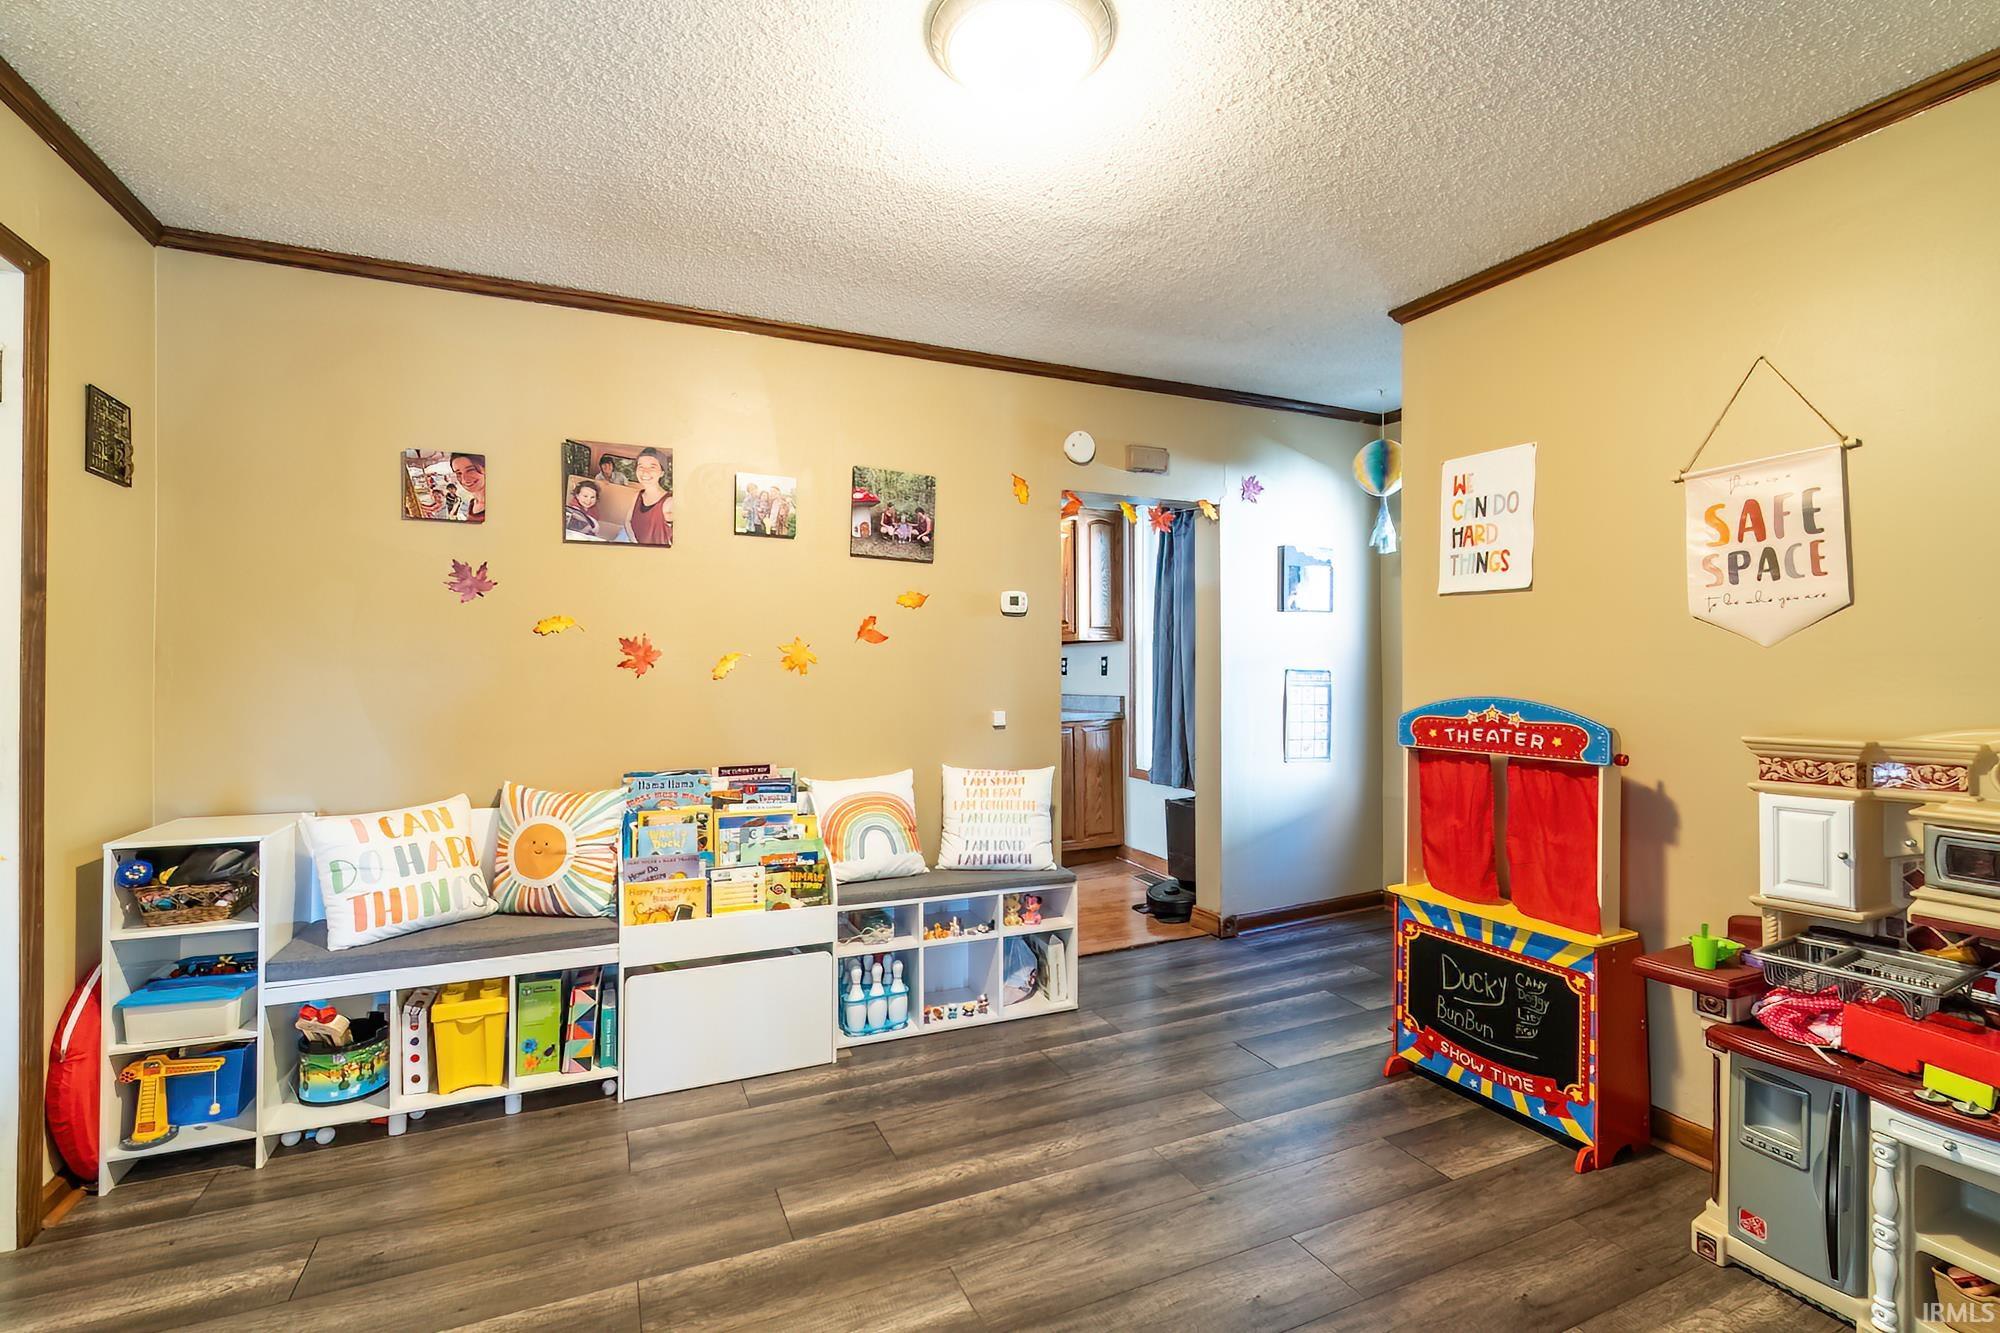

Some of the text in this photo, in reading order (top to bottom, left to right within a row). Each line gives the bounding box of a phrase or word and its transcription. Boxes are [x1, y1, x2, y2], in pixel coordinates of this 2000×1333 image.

[1452, 490, 1520, 521] CAN DO
[1453, 473, 1474, 497] WE
[1452, 523, 1498, 549] HARD
[1704, 487, 1825, 547] SAFE
[1450, 549, 1510, 576] THINGS
[1702, 539, 1828, 587] SPACE
[1444, 727, 1545, 750] THEATER
[350, 806, 455, 844] I CAN
[329, 849, 383, 895] DO
[965, 854, 983, 866] AM
[346, 873, 488, 933] THINGS
[1441, 953, 1507, 1006] Ducky
[1437, 995, 1495, 1039] BunBun
[1440, 1041, 1535, 1093] SHOW TIME
